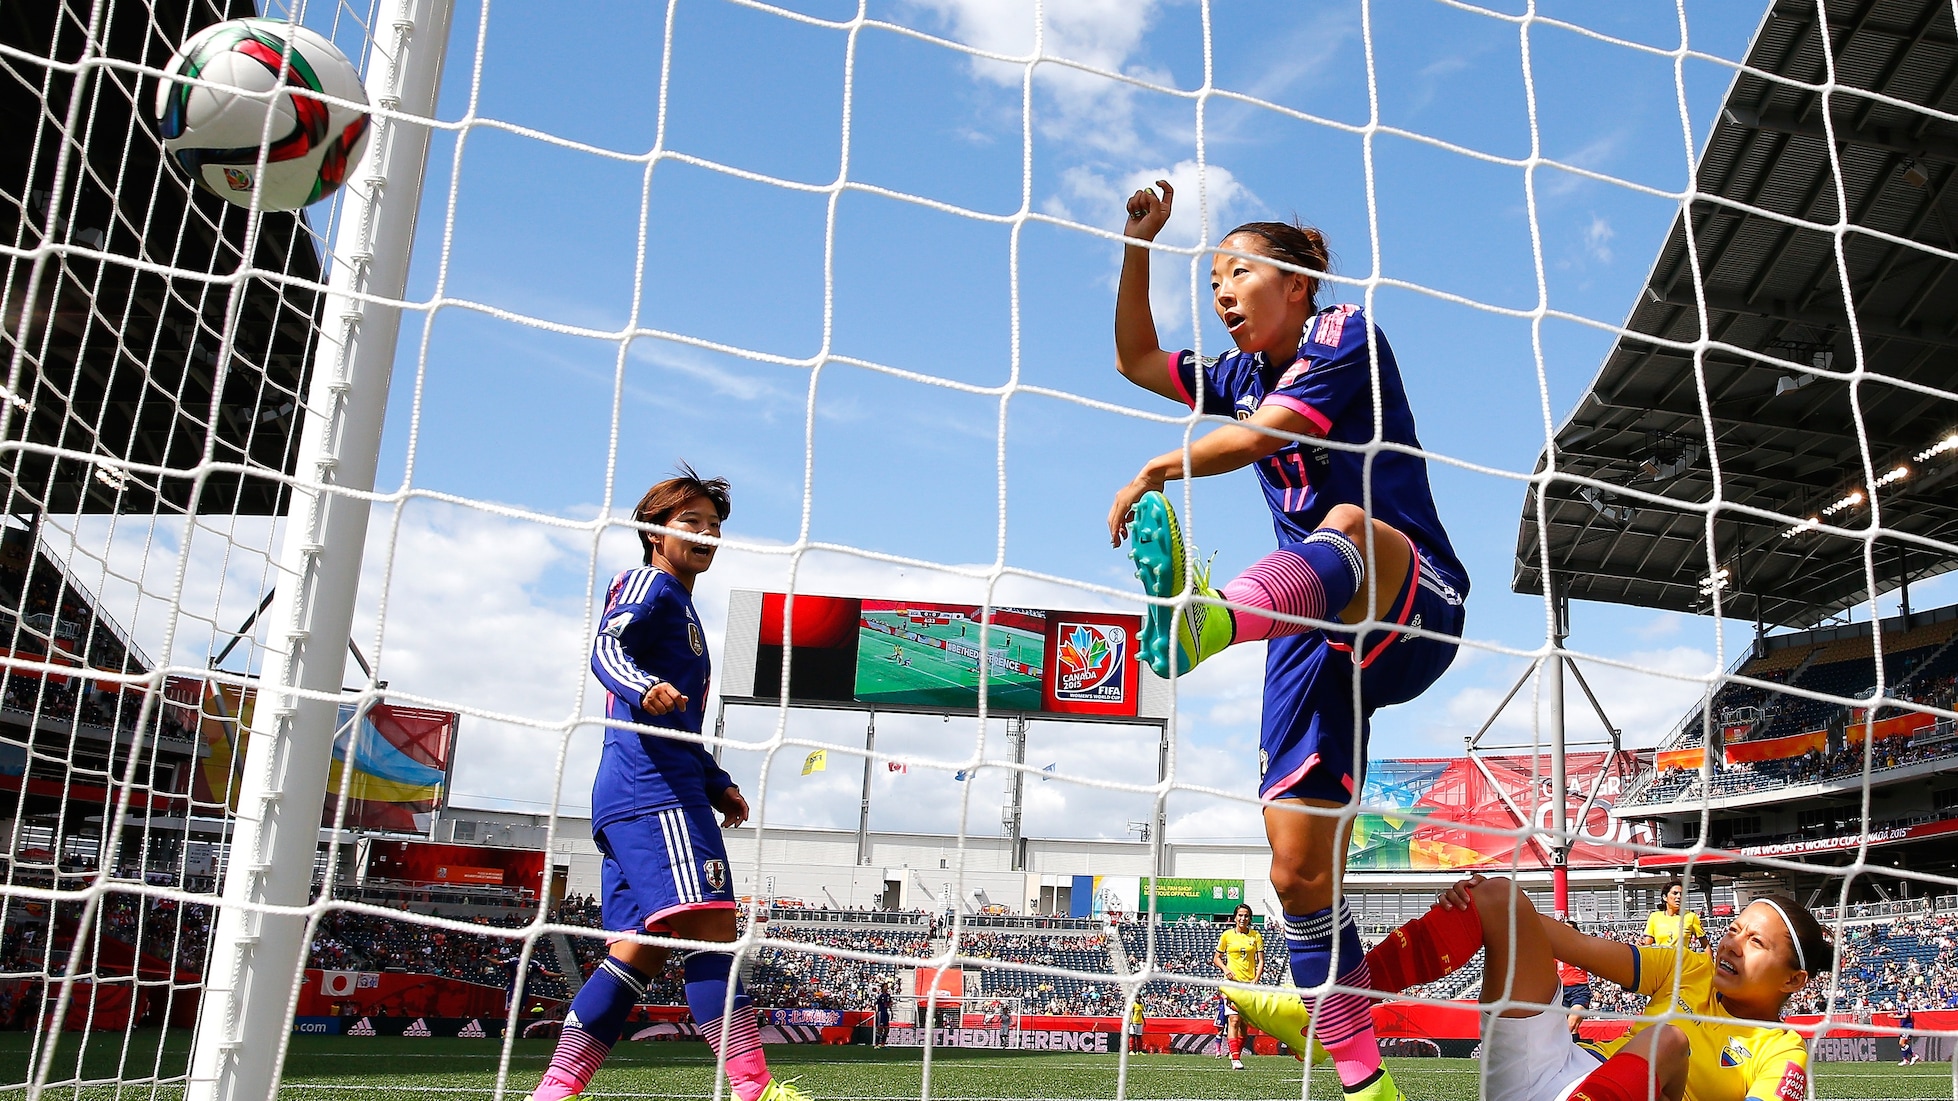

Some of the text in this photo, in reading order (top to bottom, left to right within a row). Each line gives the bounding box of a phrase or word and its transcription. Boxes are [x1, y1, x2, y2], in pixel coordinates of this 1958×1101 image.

[1271, 452, 1309, 513] 17
[1062, 671, 1097, 683] CANADA
[1063, 680, 1082, 690] 2015
[1098, 686, 1120, 696] FIFA
[1741, 844, 1762, 857] FIFA
[1761, 842, 1805, 855] WOMEN'S
[1804, 837, 1839, 850] WORLD
[1839, 835, 1857, 847] CUP
[1856, 829, 1889, 845] CNADA
[1240, 947, 1248, 961] 5
[347, 1029, 376, 1037] adidas
[402, 1029, 432, 1038] adidas
[457, 1030, 487, 1039] adidas
[1787, 1069, 1804, 1084] LIVE
